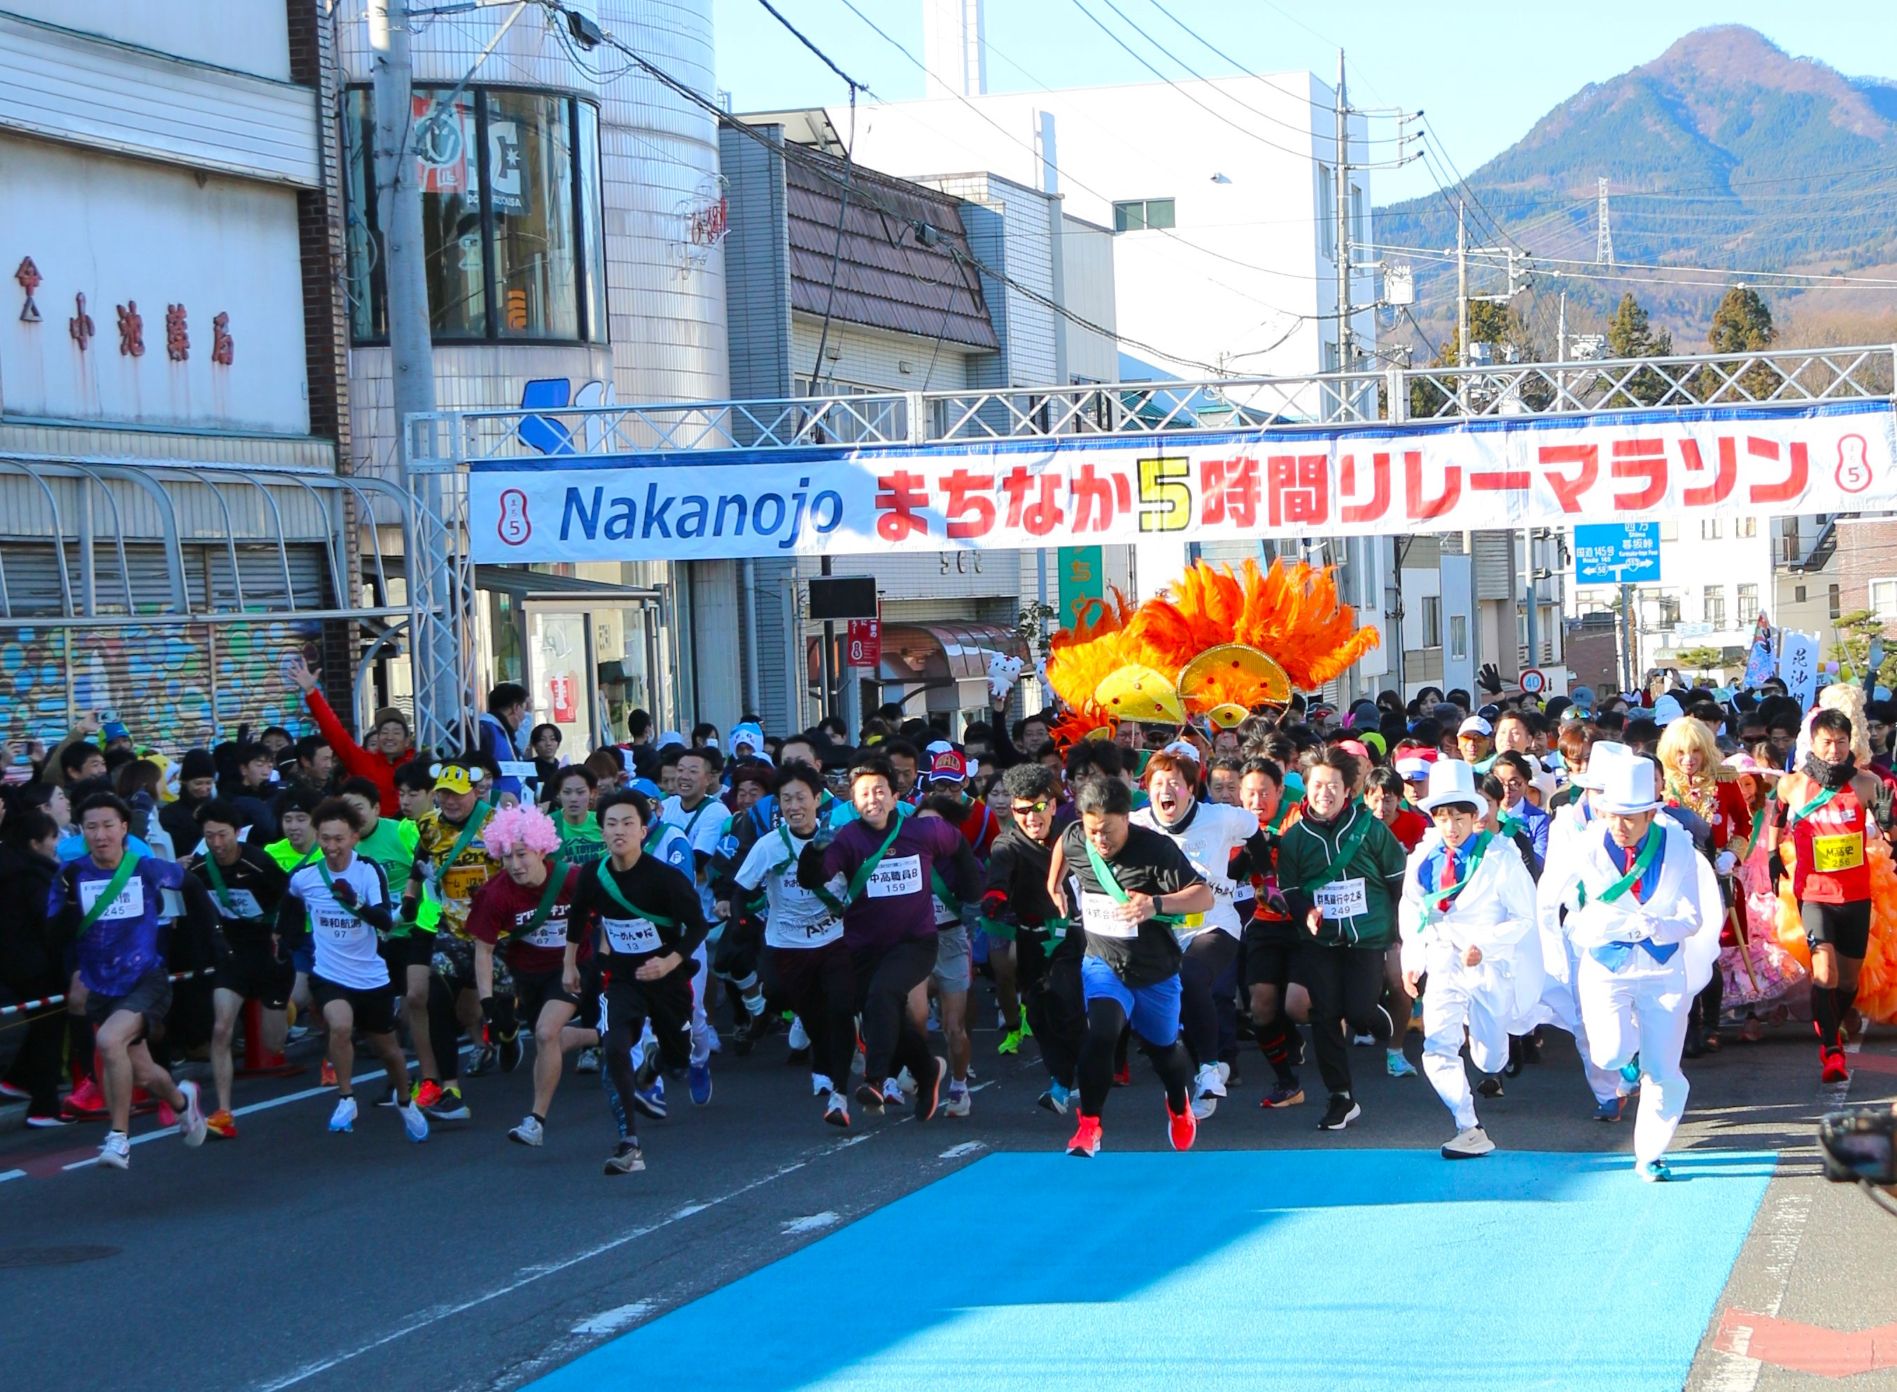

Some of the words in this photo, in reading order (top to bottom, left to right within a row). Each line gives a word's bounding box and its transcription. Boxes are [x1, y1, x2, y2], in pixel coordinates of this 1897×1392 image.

[559, 477, 843, 549] Nakanojo
[875, 434, 1809, 542] まちなか5時間リレーマラソン
[1525, 676, 1540, 688] 40
[886, 883, 905, 893] 159
[104, 906, 125, 916] 245
[1331, 906, 1350, 916] 249
[334, 930, 346, 938] 97
[627, 943, 639, 951] 13
